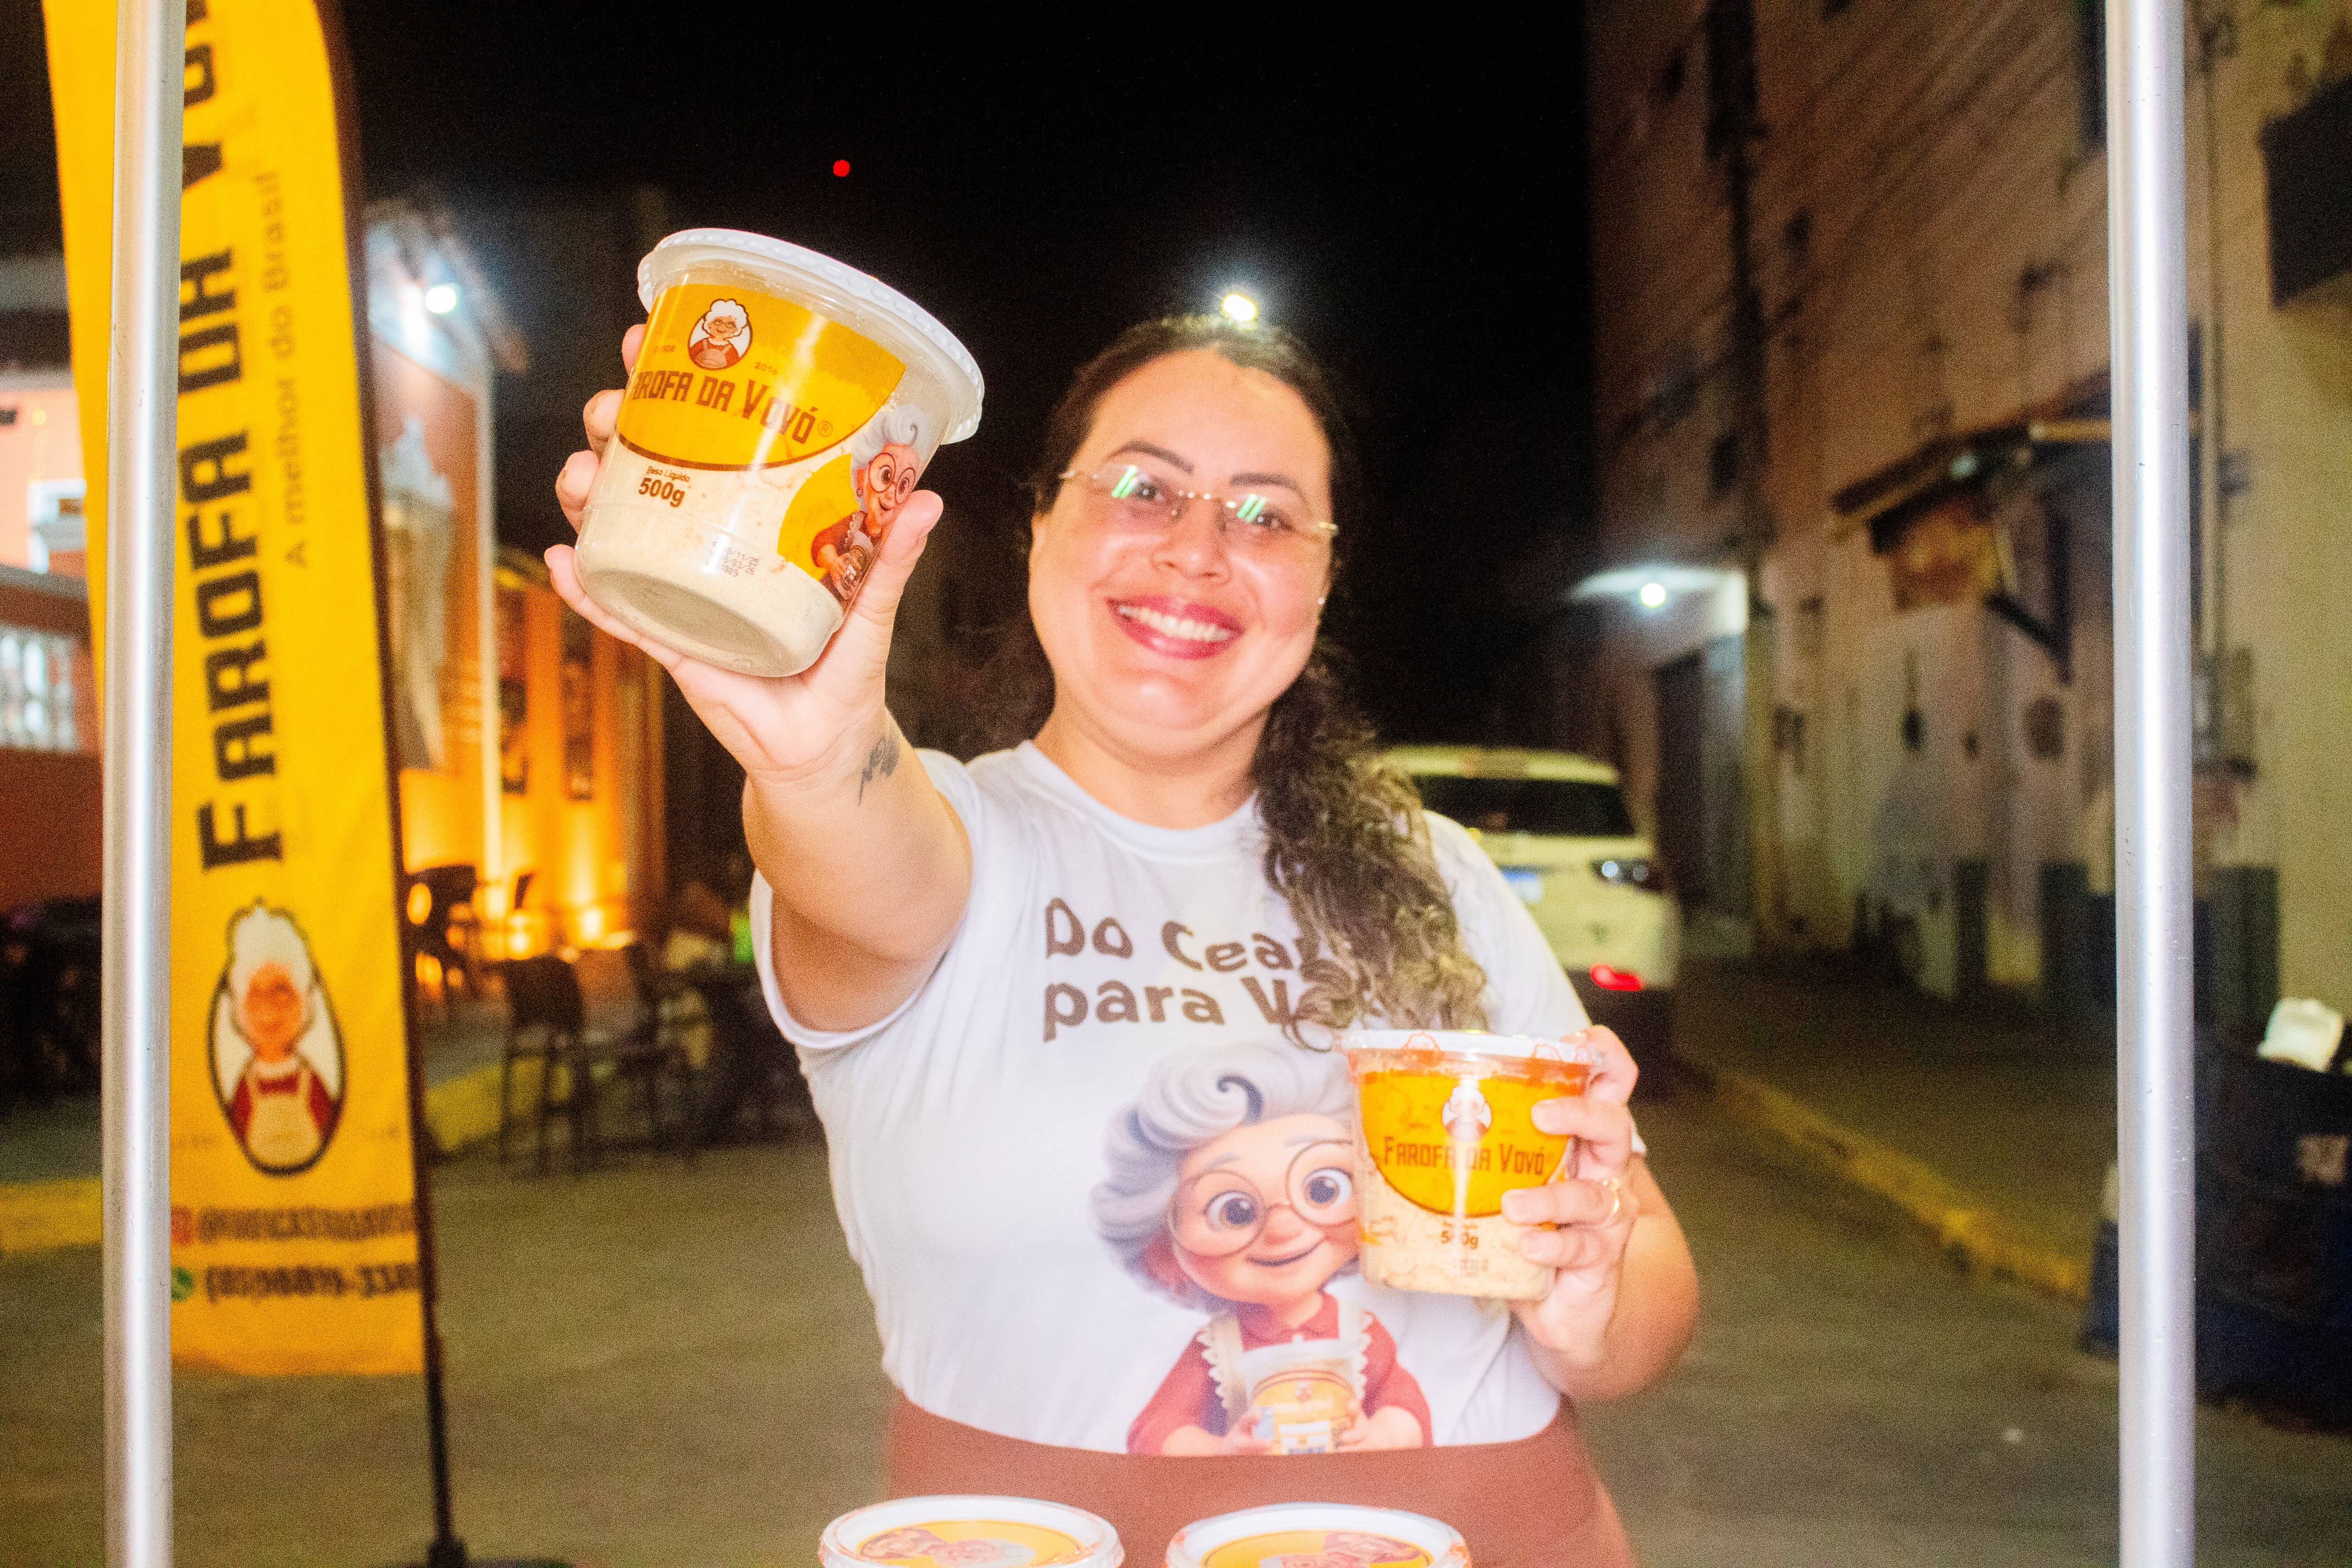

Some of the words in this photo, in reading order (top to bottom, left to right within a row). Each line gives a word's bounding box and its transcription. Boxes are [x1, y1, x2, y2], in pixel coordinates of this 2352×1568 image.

[178, 248, 242, 398] DA
[653, 344, 676, 353] DSDE
[754, 361, 778, 376] 2016
[695, 375, 735, 412] DA
[646, 466, 663, 475] Peso
[638, 477, 685, 508] 500g
[177, 429, 284, 872] FAROFA
[1045, 897, 1134, 959] Do
[1161, 920, 1309, 972] Cea
[1043, 979, 1225, 1043] para
[1383, 1136, 1455, 1169] FAROFA
[1440, 1230, 1479, 1250] 50g
